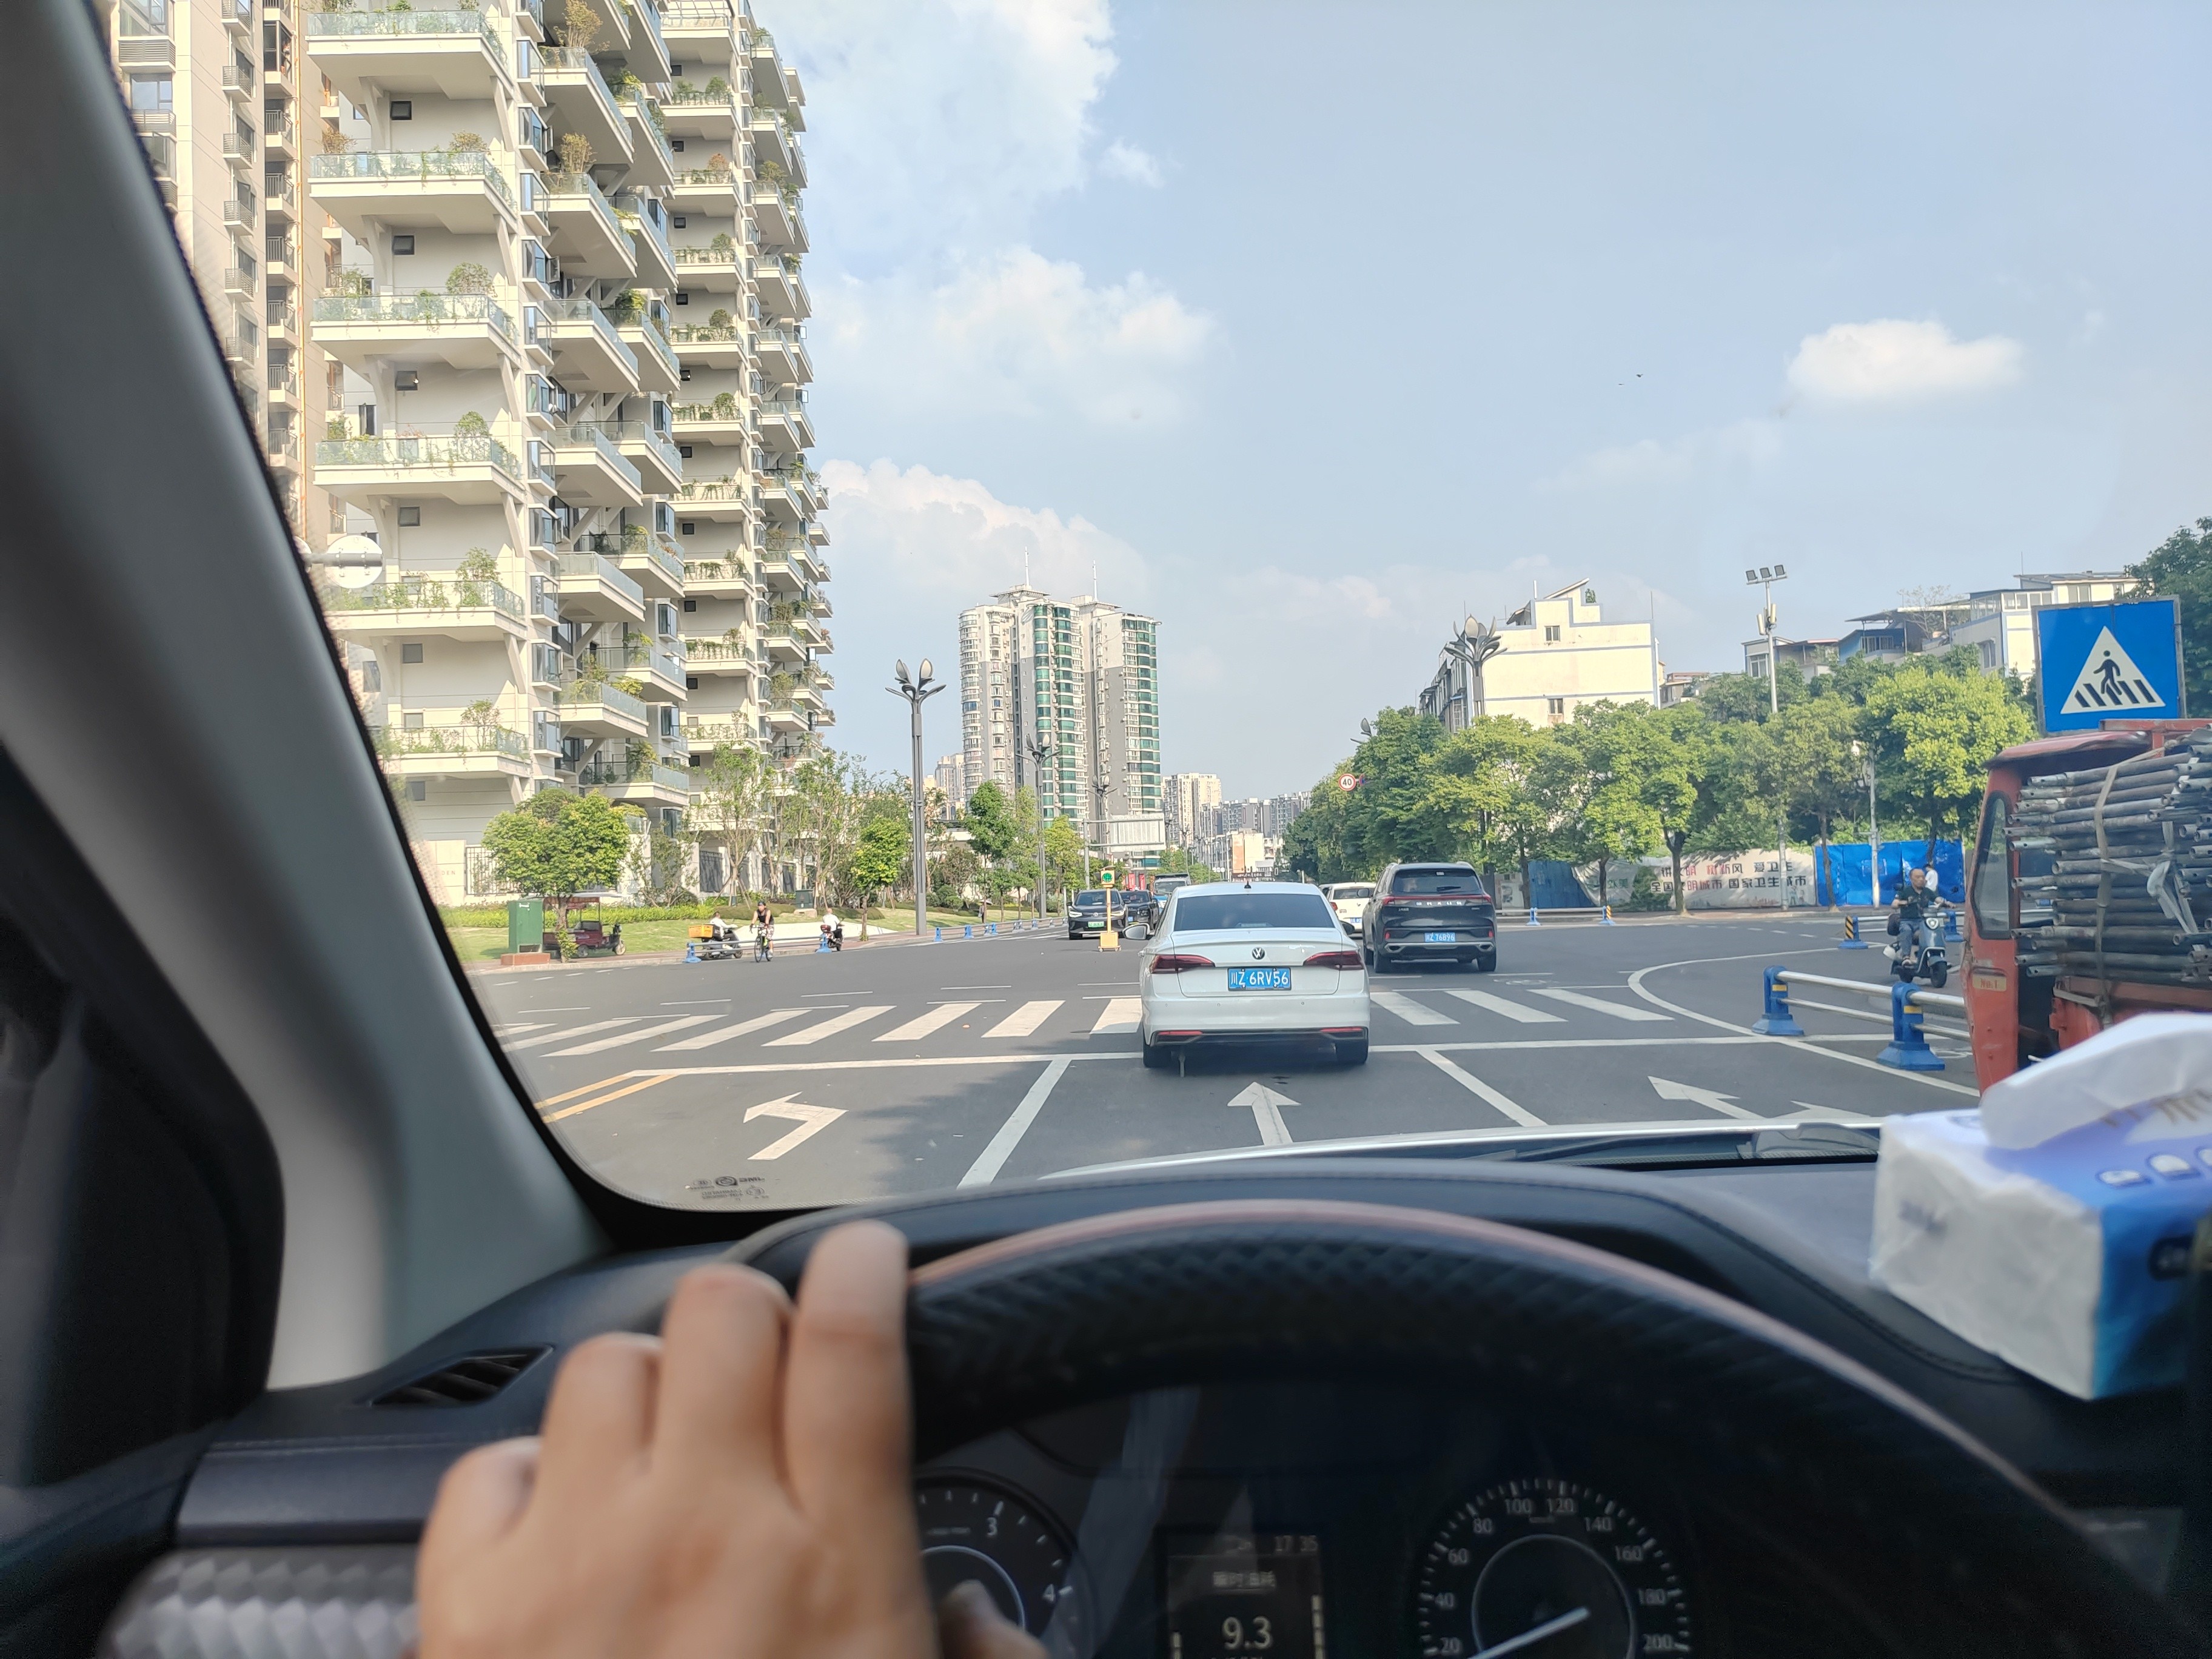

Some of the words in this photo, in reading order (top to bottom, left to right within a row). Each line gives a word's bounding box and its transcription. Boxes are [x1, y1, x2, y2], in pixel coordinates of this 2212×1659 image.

[1661, 865, 1697, 877] 讲明
[1651, 880, 1723, 893] 全国明城市
[1506, 1498, 1532, 1514] 100
[1546, 1498, 1574, 1513] 120
[986, 1517, 998, 1537] 3
[1473, 1518, 1493, 1533] 80
[1584, 1517, 1612, 1532] 140
[1042, 1583, 1055, 1603] 4
[1222, 1615, 1272, 1650] 9.3
